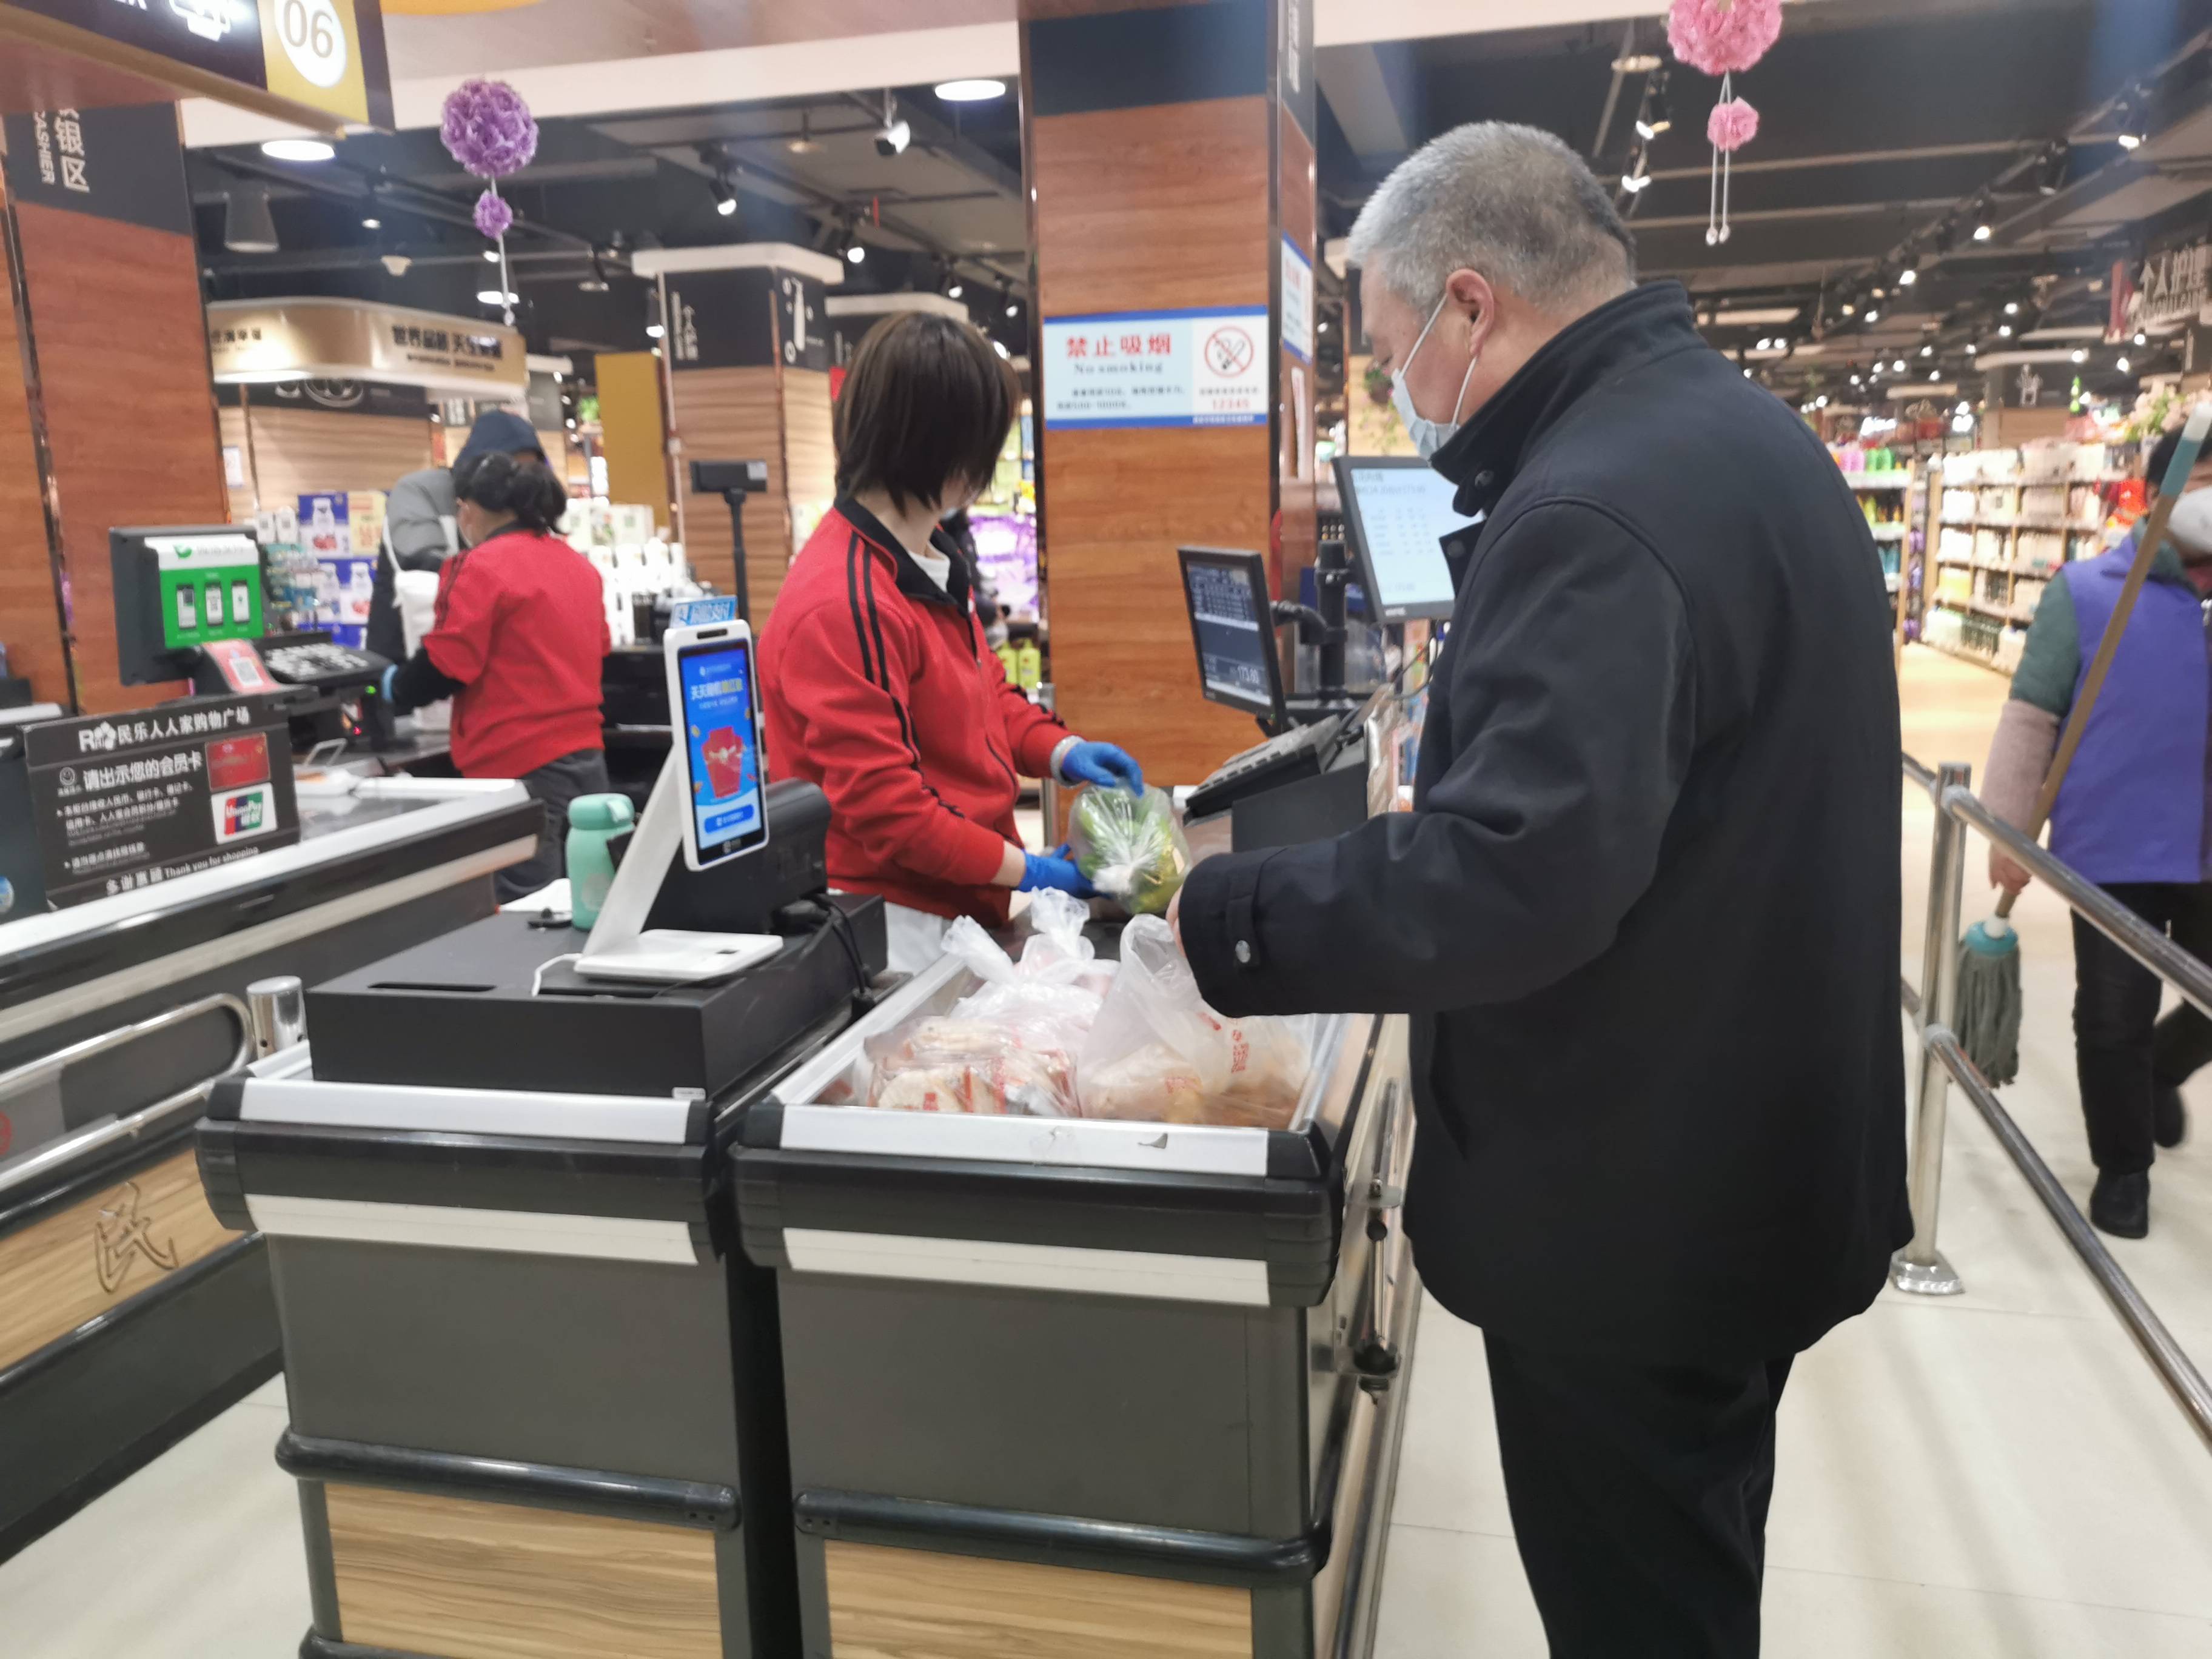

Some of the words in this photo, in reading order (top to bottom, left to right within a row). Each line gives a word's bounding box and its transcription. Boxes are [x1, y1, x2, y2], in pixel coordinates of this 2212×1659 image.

[284, 0, 333, 58] 06
[1067, 333, 1171, 358] 禁止吸烟
[1074, 363, 1094, 374] No
[1098, 361, 1163, 374] smoking
[117, 705, 250, 745] 民乐人人家购物广场
[82, 750, 203, 792] 请出示您的会员卡
[164, 862, 191, 879] Thank
[192, 859, 209, 872] you
[208, 854, 222, 866] for
[222, 845, 260, 863] shopping
